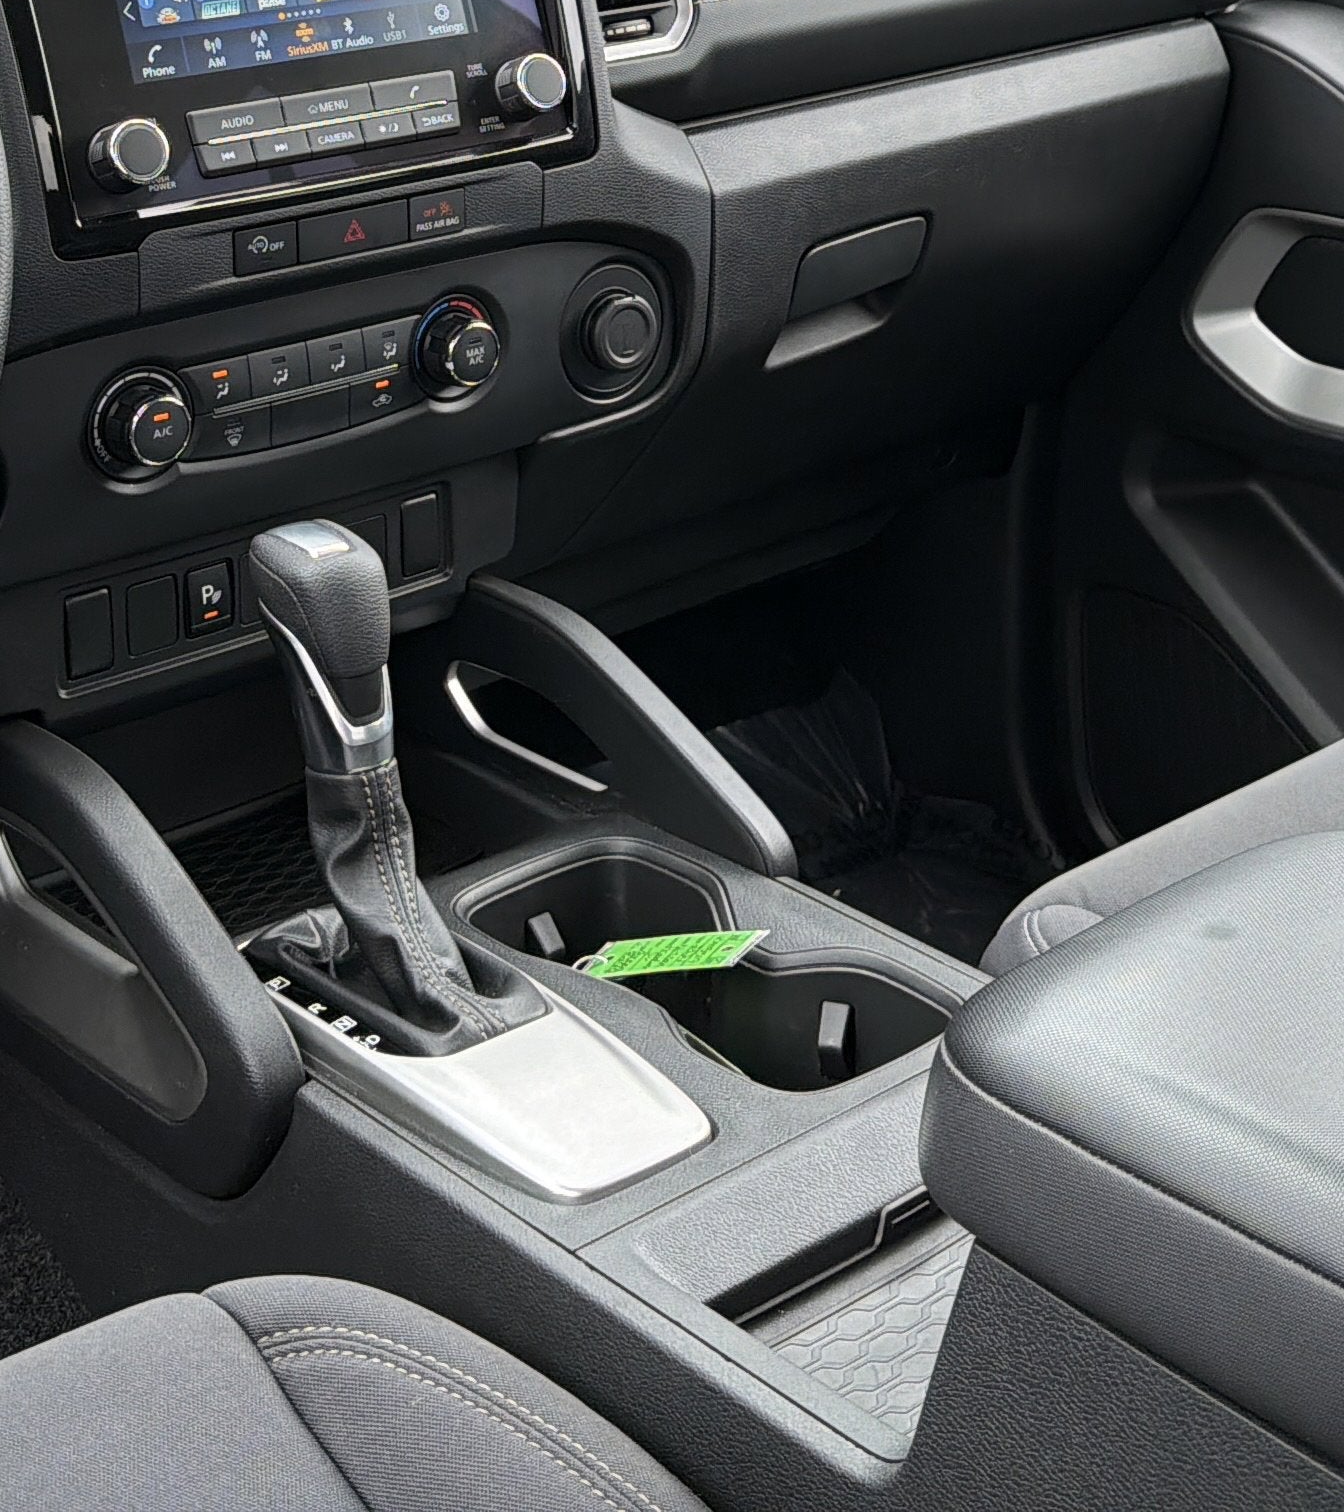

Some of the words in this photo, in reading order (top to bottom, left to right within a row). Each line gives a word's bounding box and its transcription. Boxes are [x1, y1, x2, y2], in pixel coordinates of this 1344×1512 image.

[204, 1, 240, 17] OCTANE
[382, 29, 407, 42] USB1
[427, 21, 465, 36] Settings
[287, 41, 330, 57] SiriusXM
[330, 38, 344, 51] BT
[345, 34, 375, 49] Audio
[207, 55, 227, 69] AM
[255, 49, 273, 62] FM
[142, 65, 176, 79] Phone
[318, 98, 349, 113] MENU
[220, 114, 255, 130] AUDIO
[430, 113, 455, 126] BACK
[317, 131, 356, 145] CAMERA
[148, 180, 178, 193] POWER
[416, 220, 433, 232] PASS
[269, 240, 285, 252] OFF
[465, 345, 486, 358] MAX
[468, 354, 485, 366] A/C
[152, 425, 174, 440] A/C
